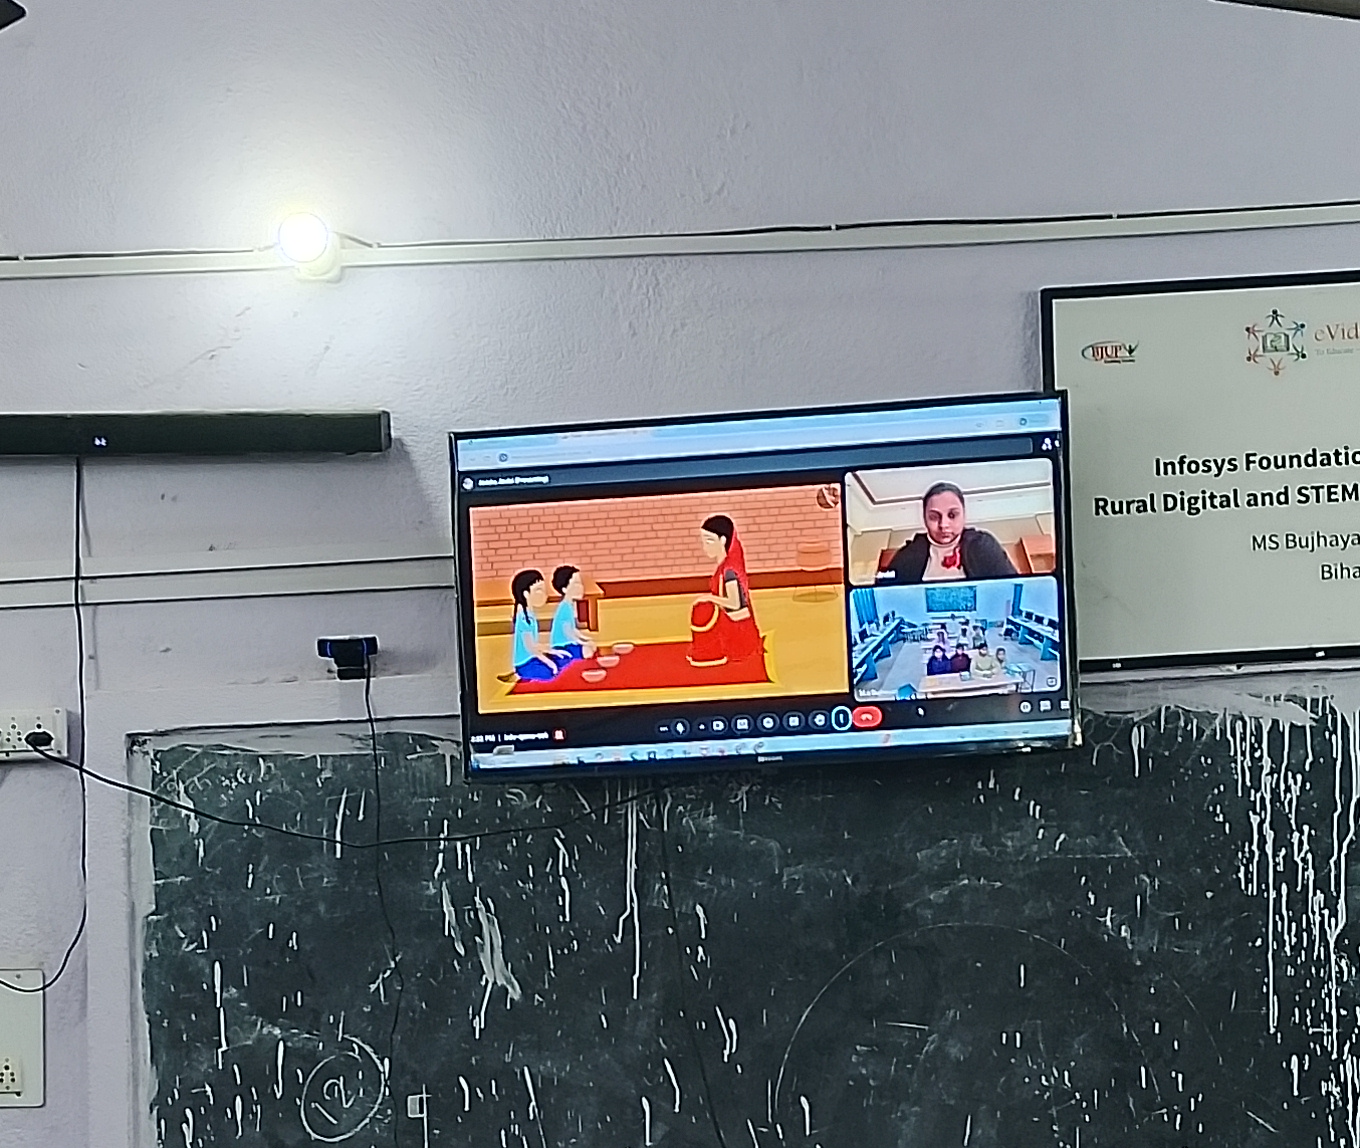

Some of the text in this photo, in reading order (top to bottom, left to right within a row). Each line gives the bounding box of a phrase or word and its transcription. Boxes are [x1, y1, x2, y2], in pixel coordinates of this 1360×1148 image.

[1155, 455, 1238, 477] Infosys
[1094, 493, 1156, 516] Rural
[1162, 488, 1240, 515] Digital
[1246, 485, 1290, 508] and
[1296, 482, 1360, 504] STEM
[1252, 534, 1280, 551] MS
